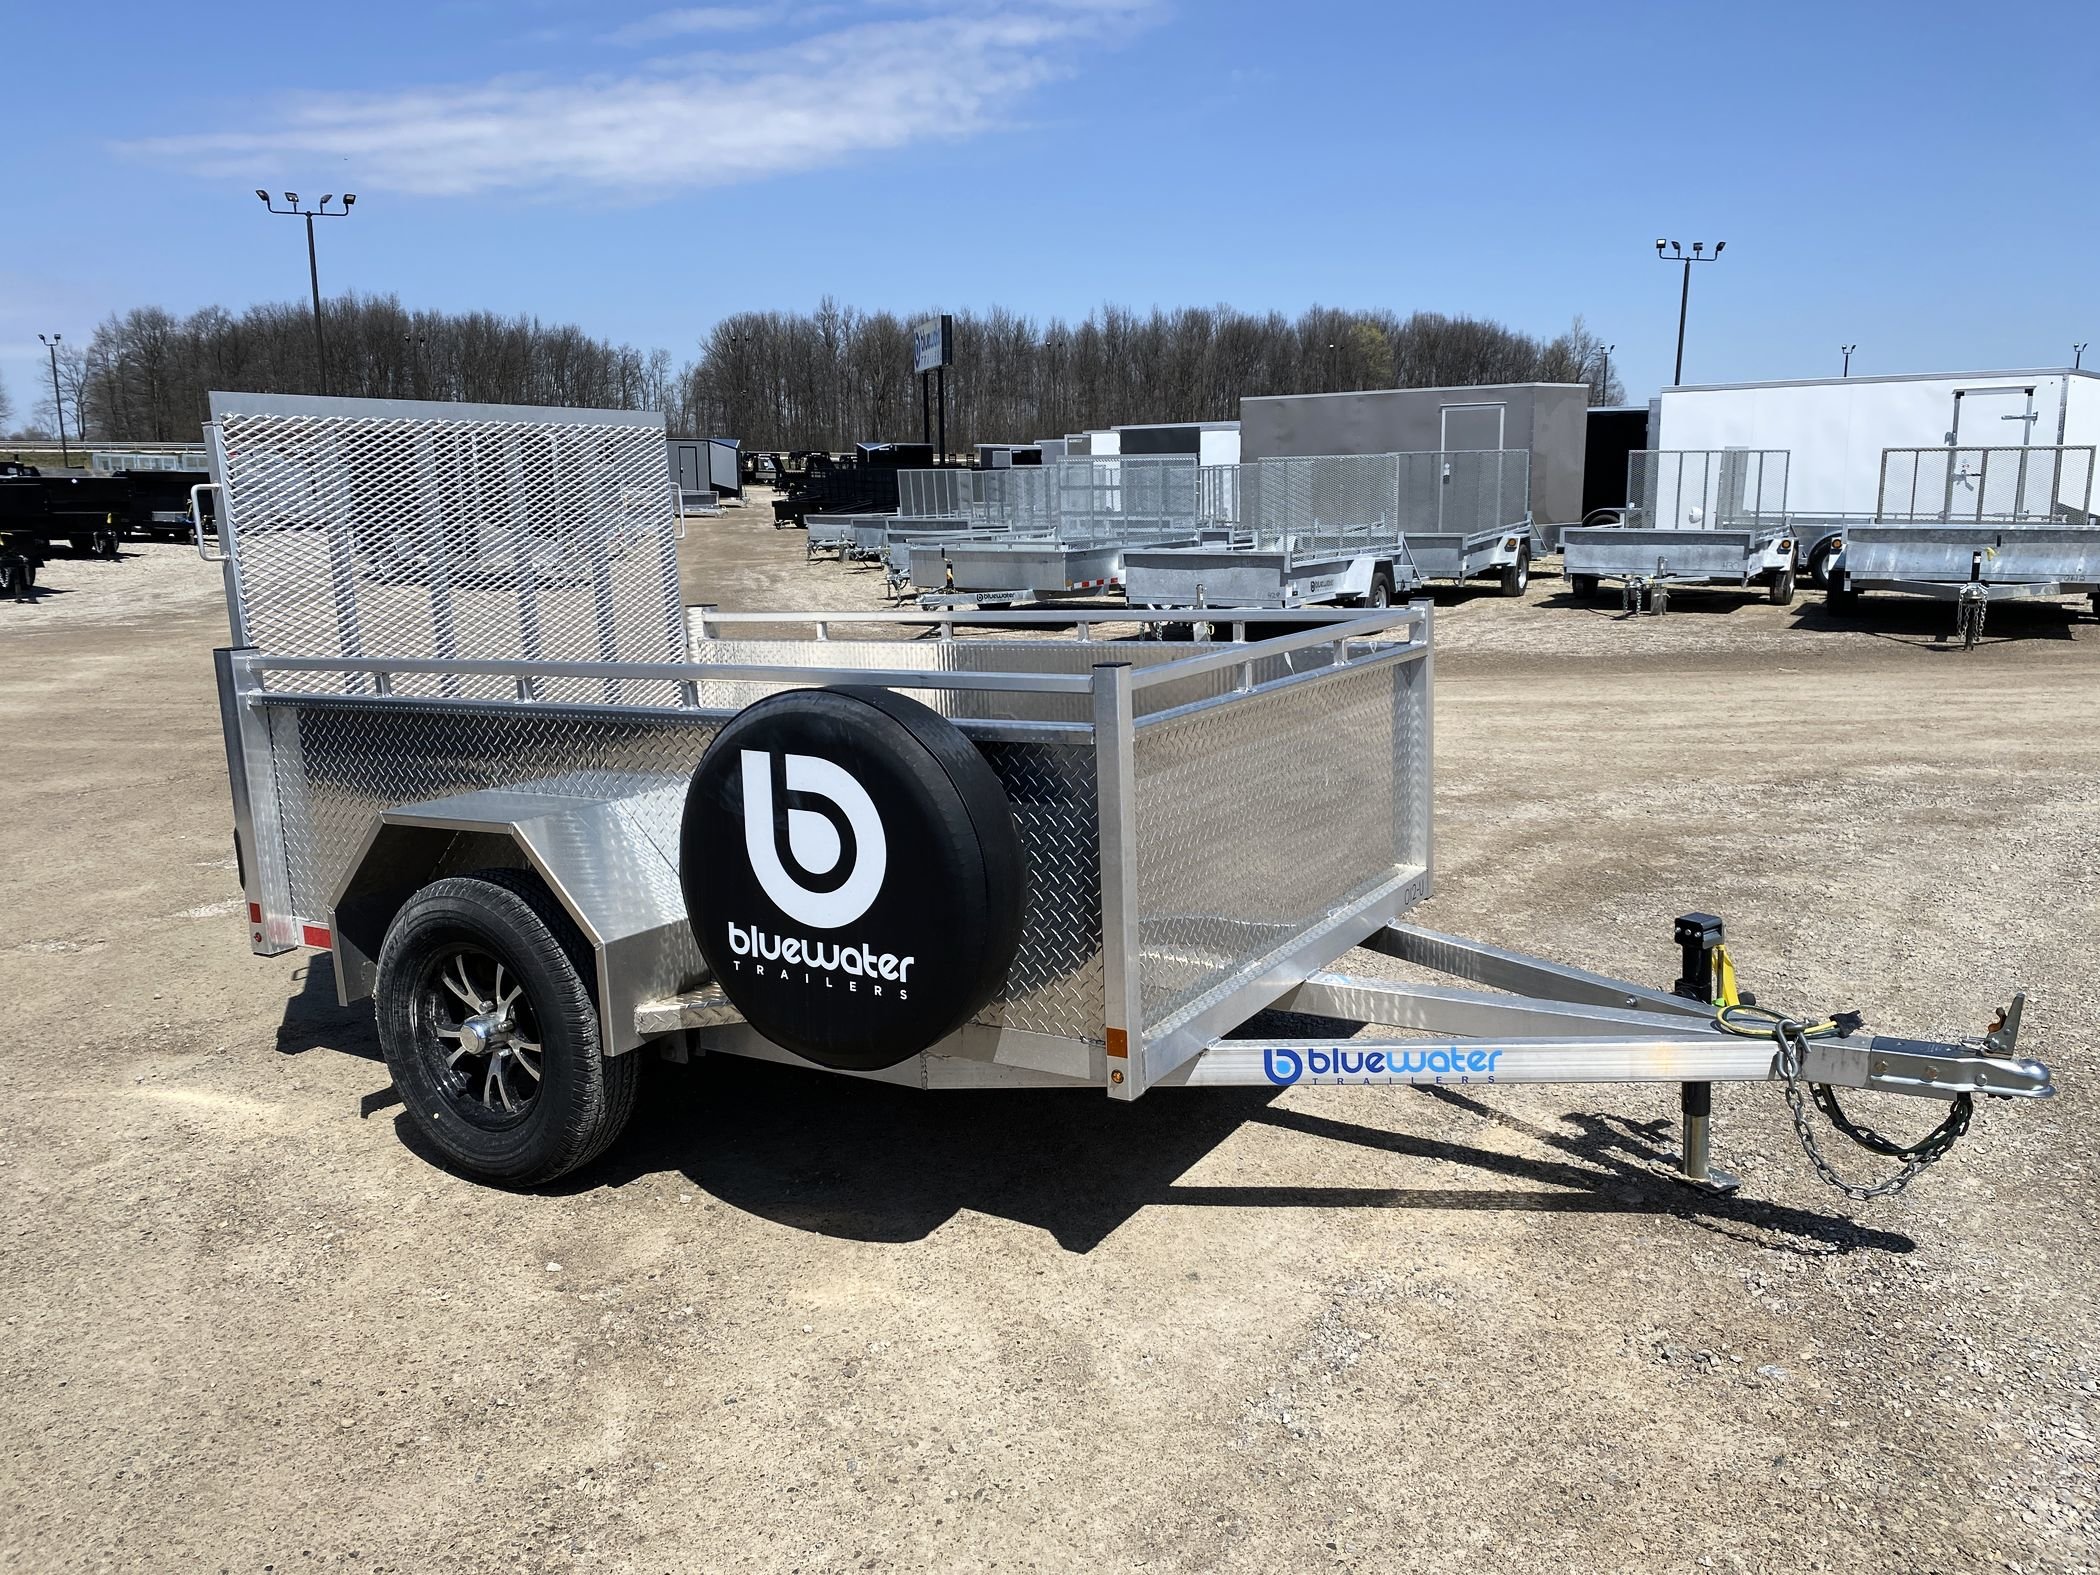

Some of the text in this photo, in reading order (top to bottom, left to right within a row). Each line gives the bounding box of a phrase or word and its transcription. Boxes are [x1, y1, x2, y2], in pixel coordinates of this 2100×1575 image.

[728, 921, 915, 983] bluewater
[733, 960, 908, 1000] TRAILERS
[1308, 1046, 1503, 1074] bluewater
[1313, 1075, 1496, 1085] TRAILERS
